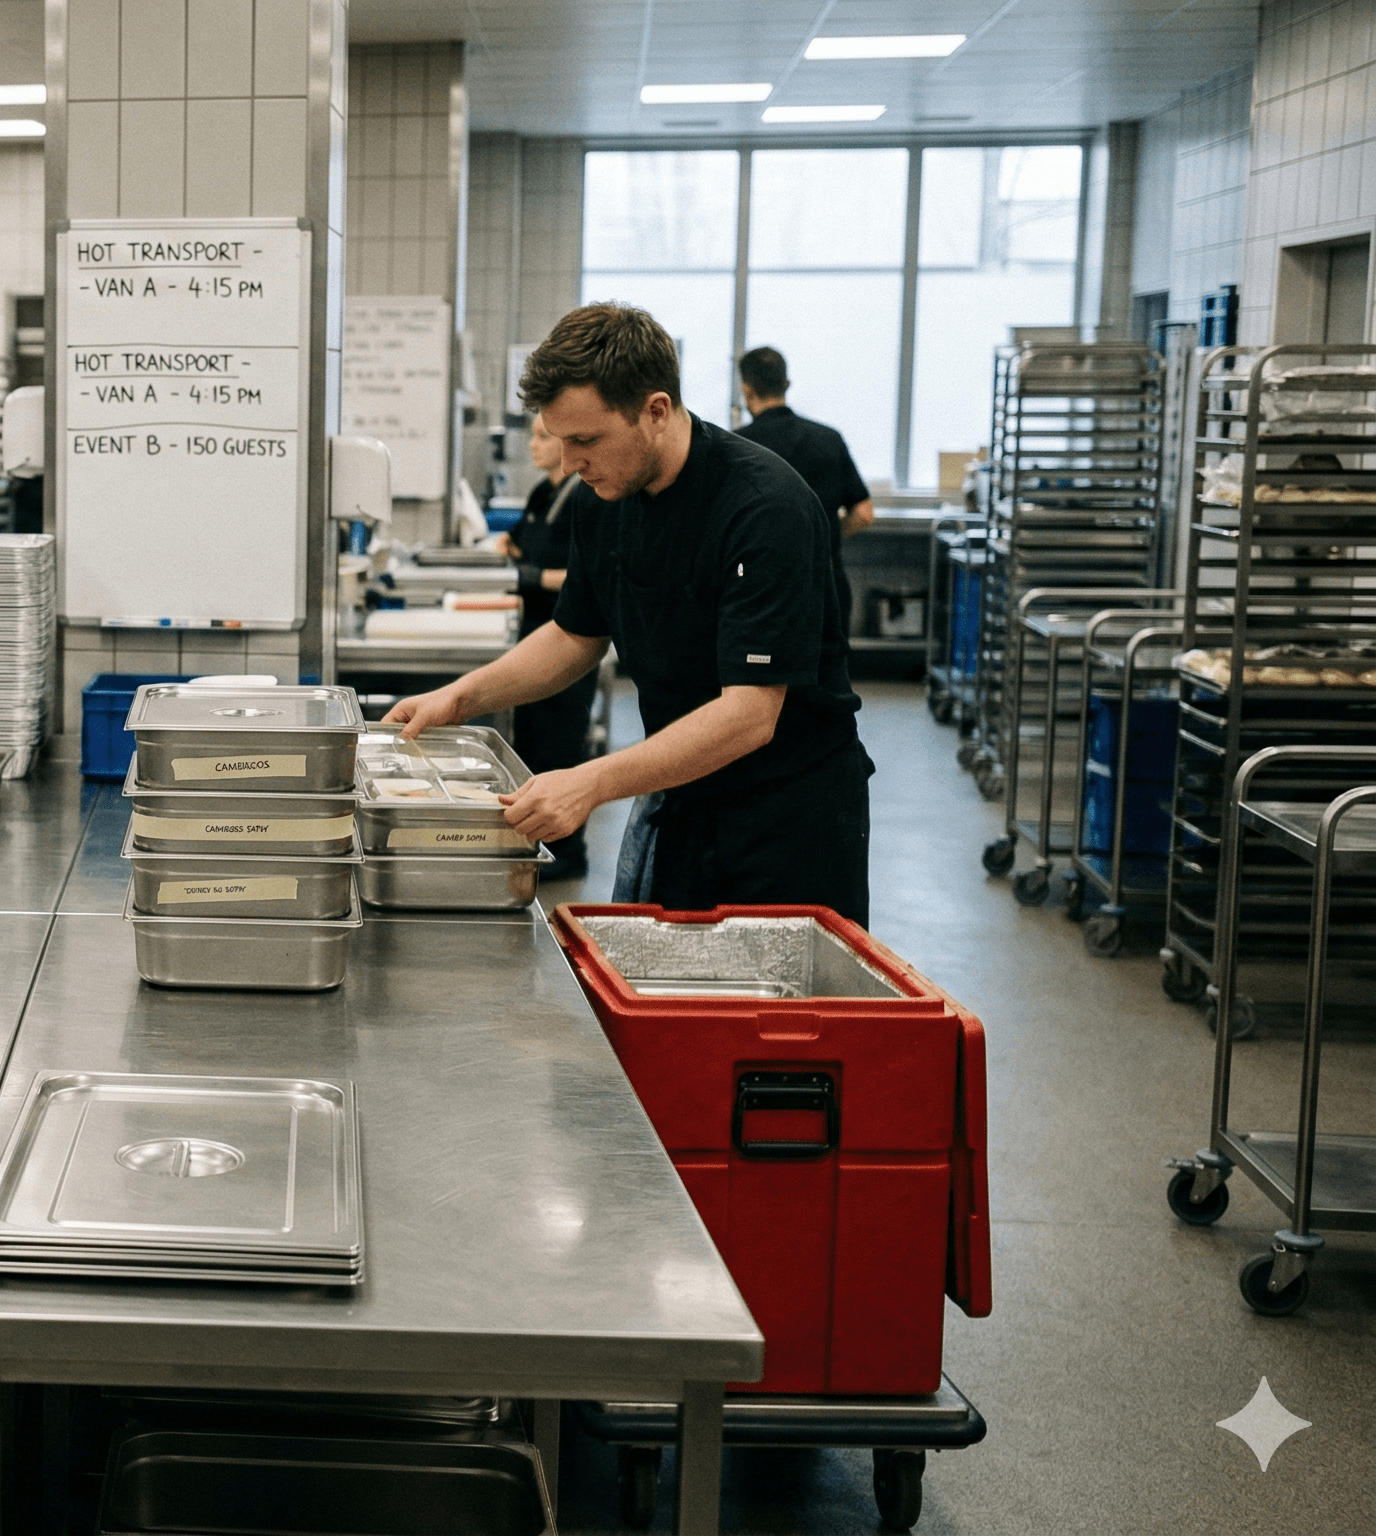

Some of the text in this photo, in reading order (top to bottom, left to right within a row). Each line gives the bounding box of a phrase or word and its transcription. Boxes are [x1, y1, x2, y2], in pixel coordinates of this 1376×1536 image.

[76, 241, 117, 263] HOT
[126, 240, 246, 262] TRANSPORT
[94, 277, 135, 298] VAN
[142, 276, 158, 298] A
[187, 275, 233, 299] 4:15
[238, 280, 264, 299] PM
[74, 352, 114, 373] HOT
[120, 352, 234, 373] TRANSPORT
[95, 384, 135, 404] VAN
[143, 382, 158, 404] A
[188, 384, 232, 405] 4:15
[236, 387, 262, 406] PM
[73, 434, 138, 455] EVENT
[145, 433, 162, 457] B
[186, 435, 218, 456] 150
[222, 436, 287, 459] GUESTS
